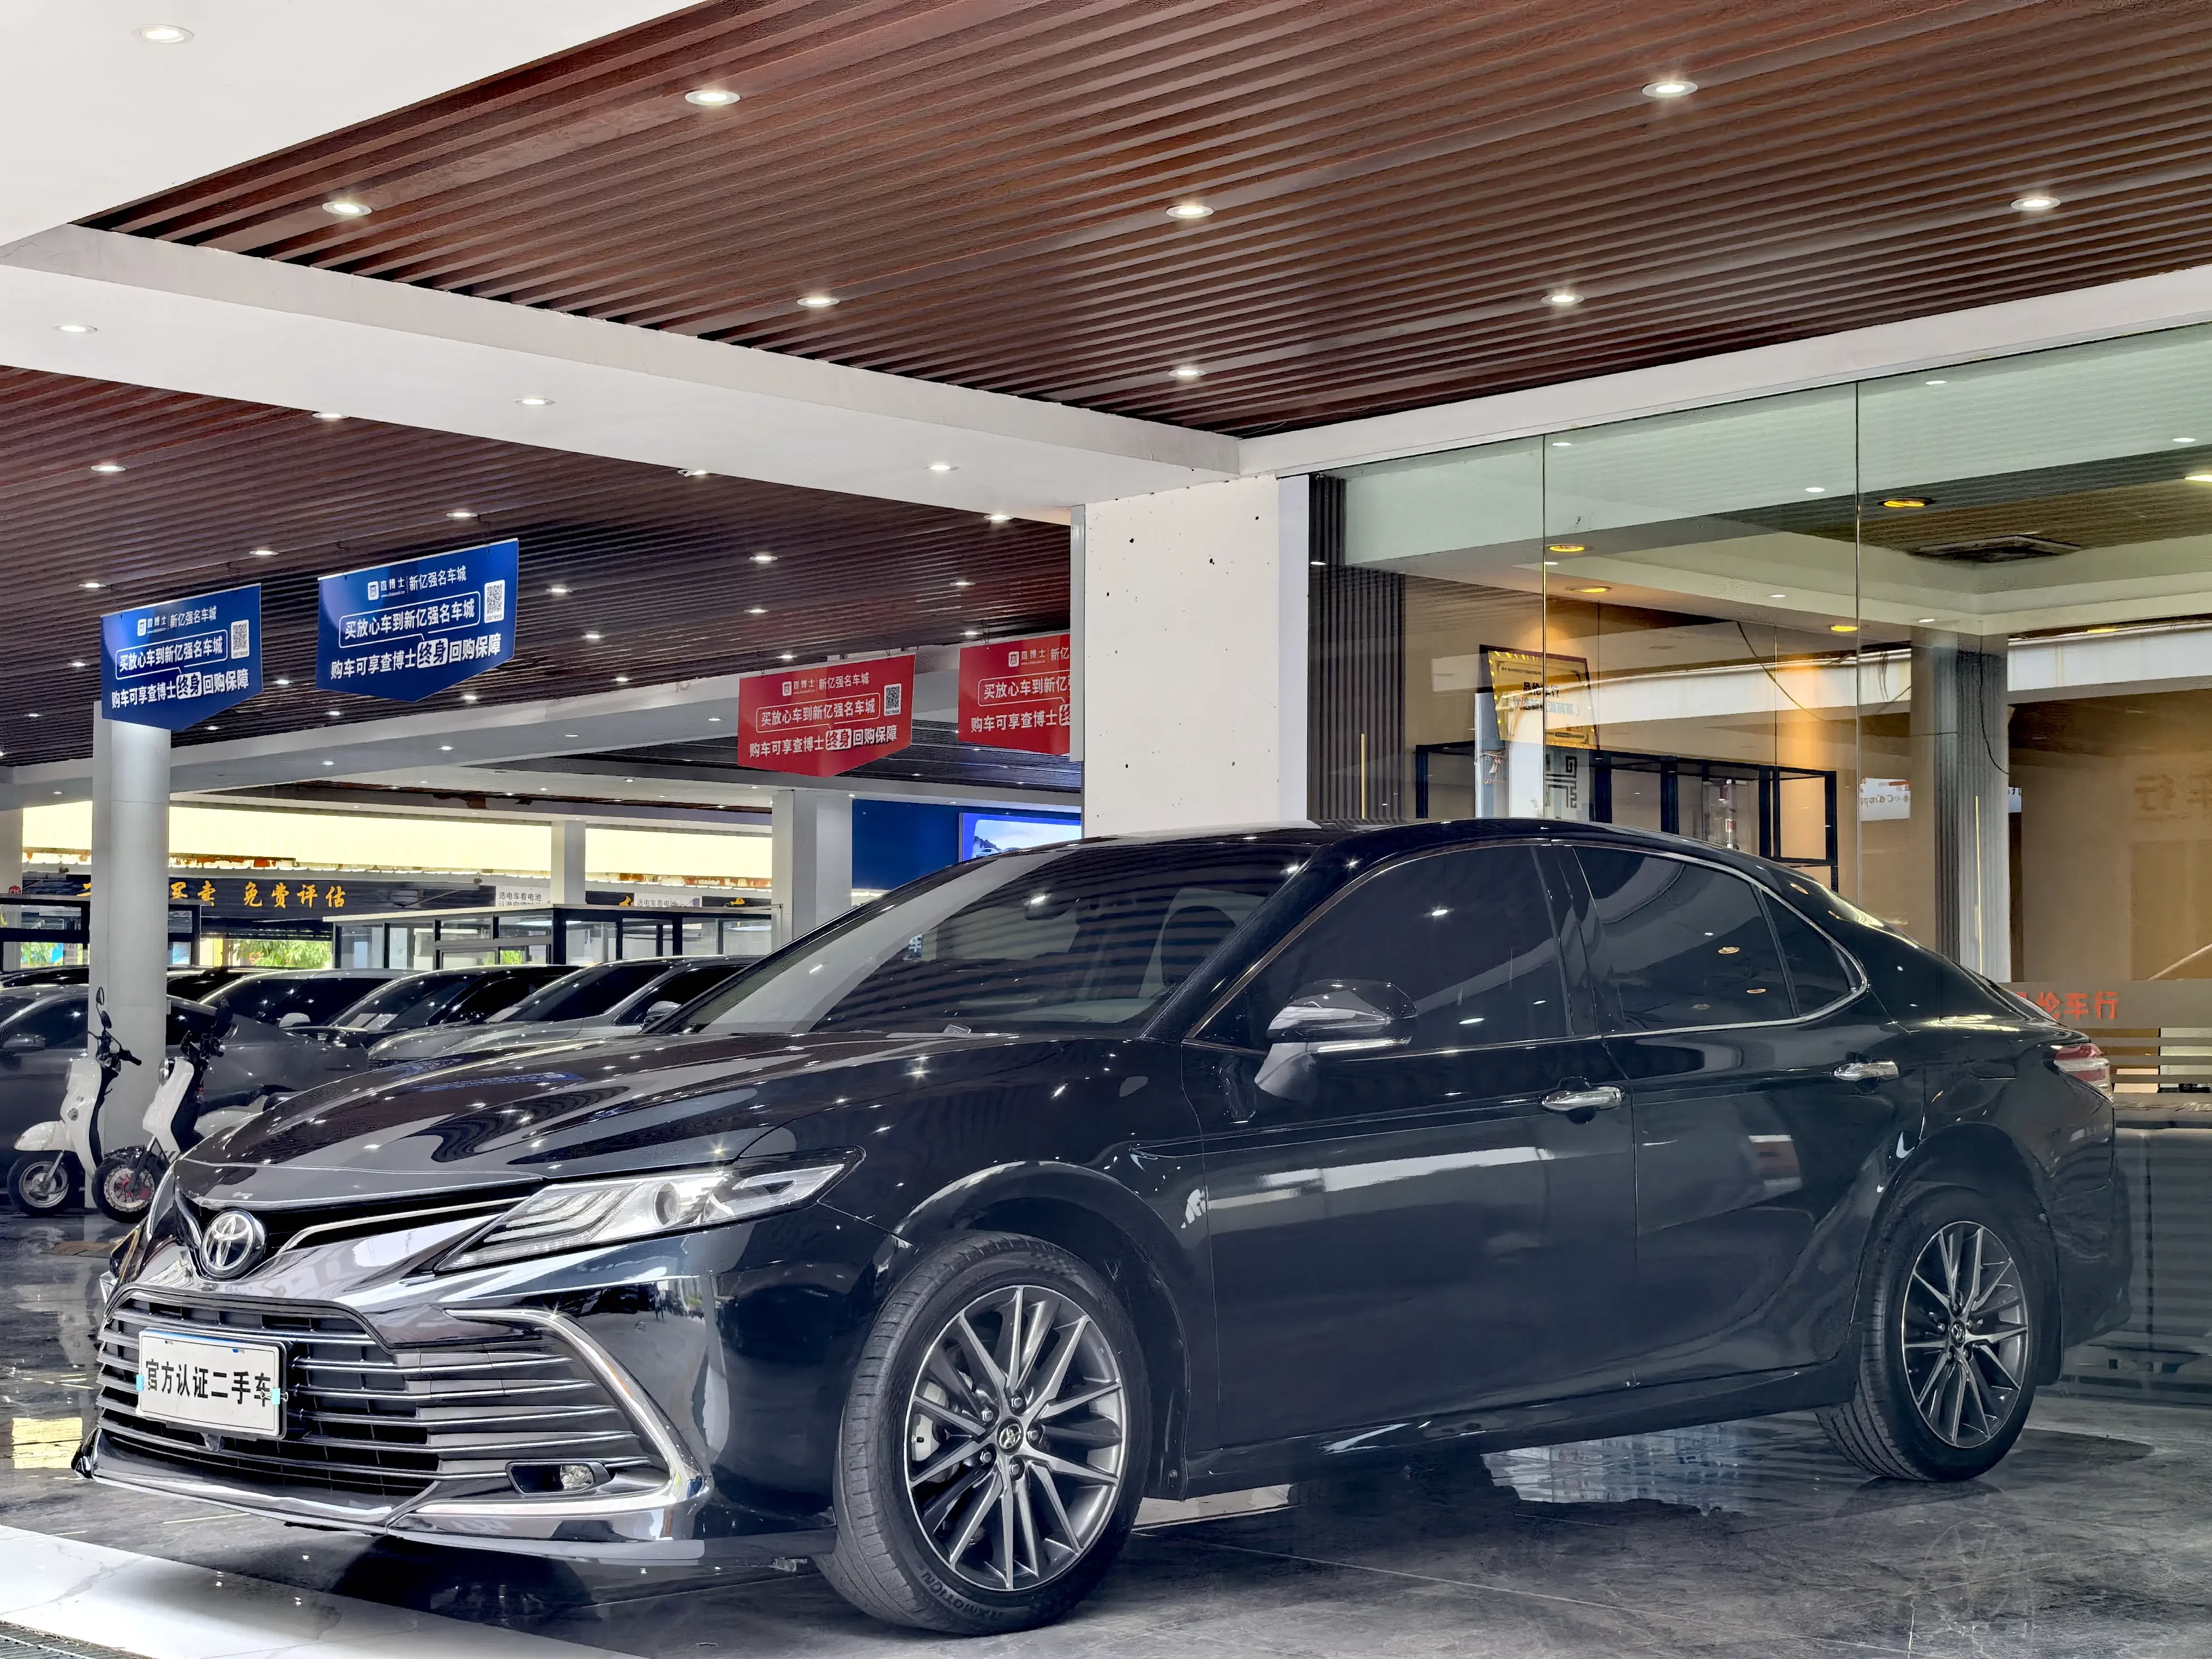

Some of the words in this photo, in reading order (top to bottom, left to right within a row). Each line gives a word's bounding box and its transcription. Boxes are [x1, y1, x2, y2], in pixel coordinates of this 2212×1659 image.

[409, 565, 467, 591] 新亿强名车城
[170, 605, 217, 628] 新亿强名车城
[345, 598, 475, 640] 买放心车到新亿强名车城
[119, 635, 223, 672] 买放心车到新亿强名车城
[331, 632, 502, 679] 购车可享查博士终身回购保障
[111, 668, 249, 709] 购车可享查博士终身回购保障
[818, 672, 869, 691] 新亿强名车城
[984, 675, 1070, 700] 买放心车到新亿
[761, 698, 875, 726] 买放心车到新亿强名车城
[749, 724, 897, 758] 购车可享查博士终身回购保障
[244, 881, 346, 909] 免费评估
[499, 892, 542, 901] 选电车看电池
[145, 1358, 272, 1407] 官方认证二手车
